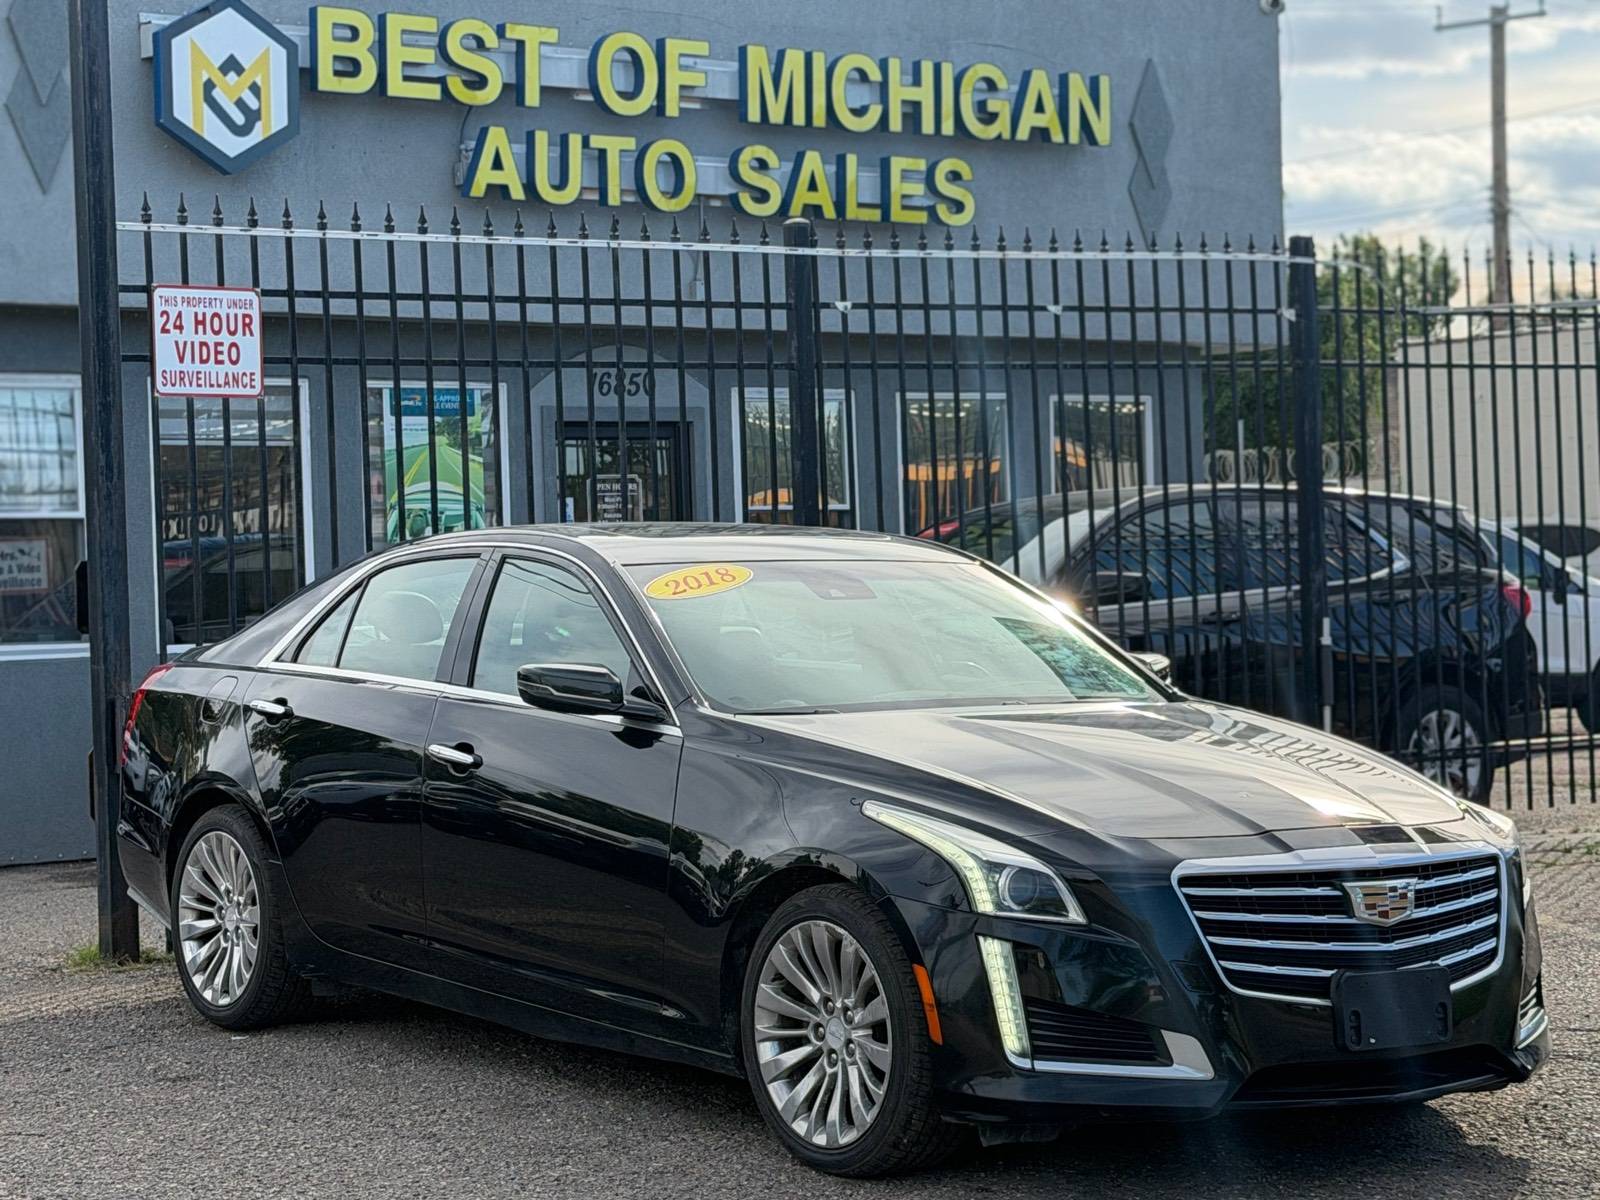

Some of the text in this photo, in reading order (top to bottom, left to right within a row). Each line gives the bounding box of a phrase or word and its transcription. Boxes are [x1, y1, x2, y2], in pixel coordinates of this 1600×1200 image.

[315, 5, 1112, 146] BEST OF MICHIGAN
[468, 125, 976, 227] AUTO SALES
[158, 295, 254, 311] THIS PROPERTY UNDER
[160, 310, 255, 337] 24 HOUR
[174, 340, 241, 366] VIDEO
[161, 369, 256, 389] SURVEILLANCE
[664, 567, 737, 596] 2018
